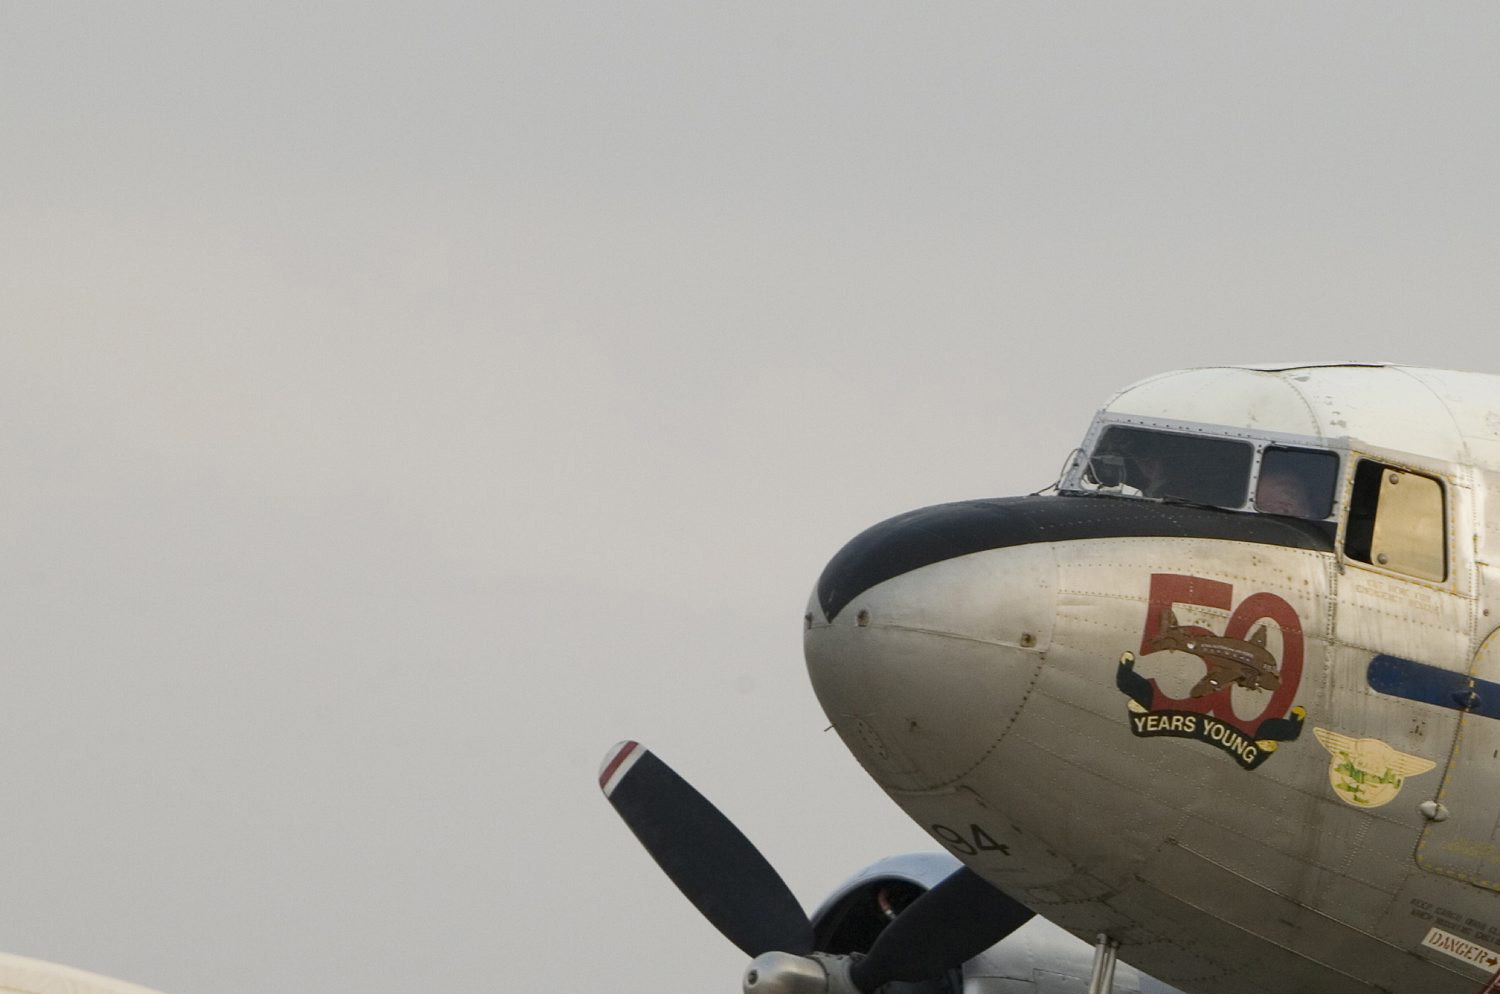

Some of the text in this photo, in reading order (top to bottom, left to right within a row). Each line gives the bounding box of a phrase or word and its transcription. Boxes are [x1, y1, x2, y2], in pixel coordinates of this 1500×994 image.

[1140, 573, 1304, 738] 50
[1134, 714, 1258, 763] YEARS YOUNG
[1428, 931, 1488, 964] DANGER
